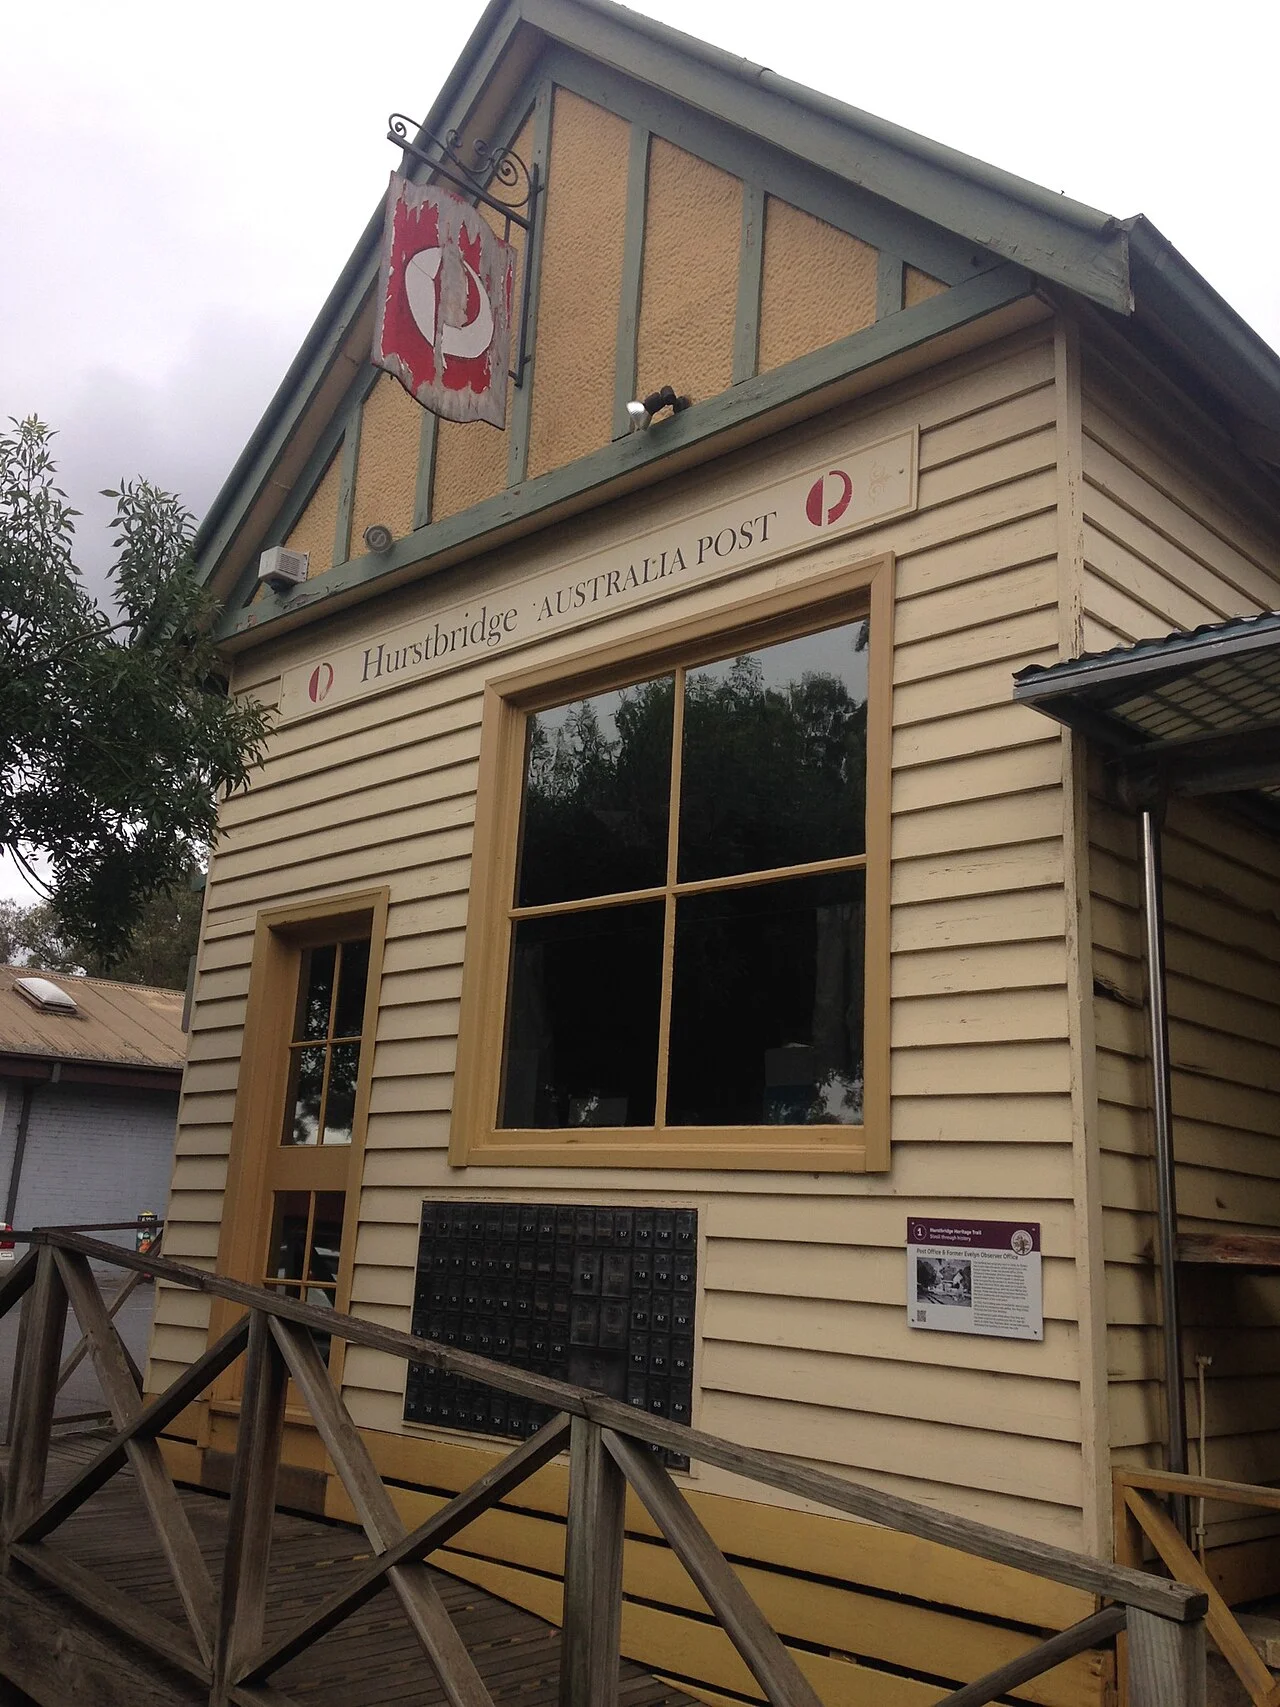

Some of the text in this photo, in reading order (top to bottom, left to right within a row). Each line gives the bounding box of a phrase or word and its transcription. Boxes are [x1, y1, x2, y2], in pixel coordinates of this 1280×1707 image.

[360, 511, 777, 683] Hurstbridge AUSTRALIA POST
[917, 1228, 923, 1236] 1
[946, 1249, 963, 1257] Former
[964, 1250, 980, 1259] Evelyn
[981, 1251, 1002, 1259] Observer
